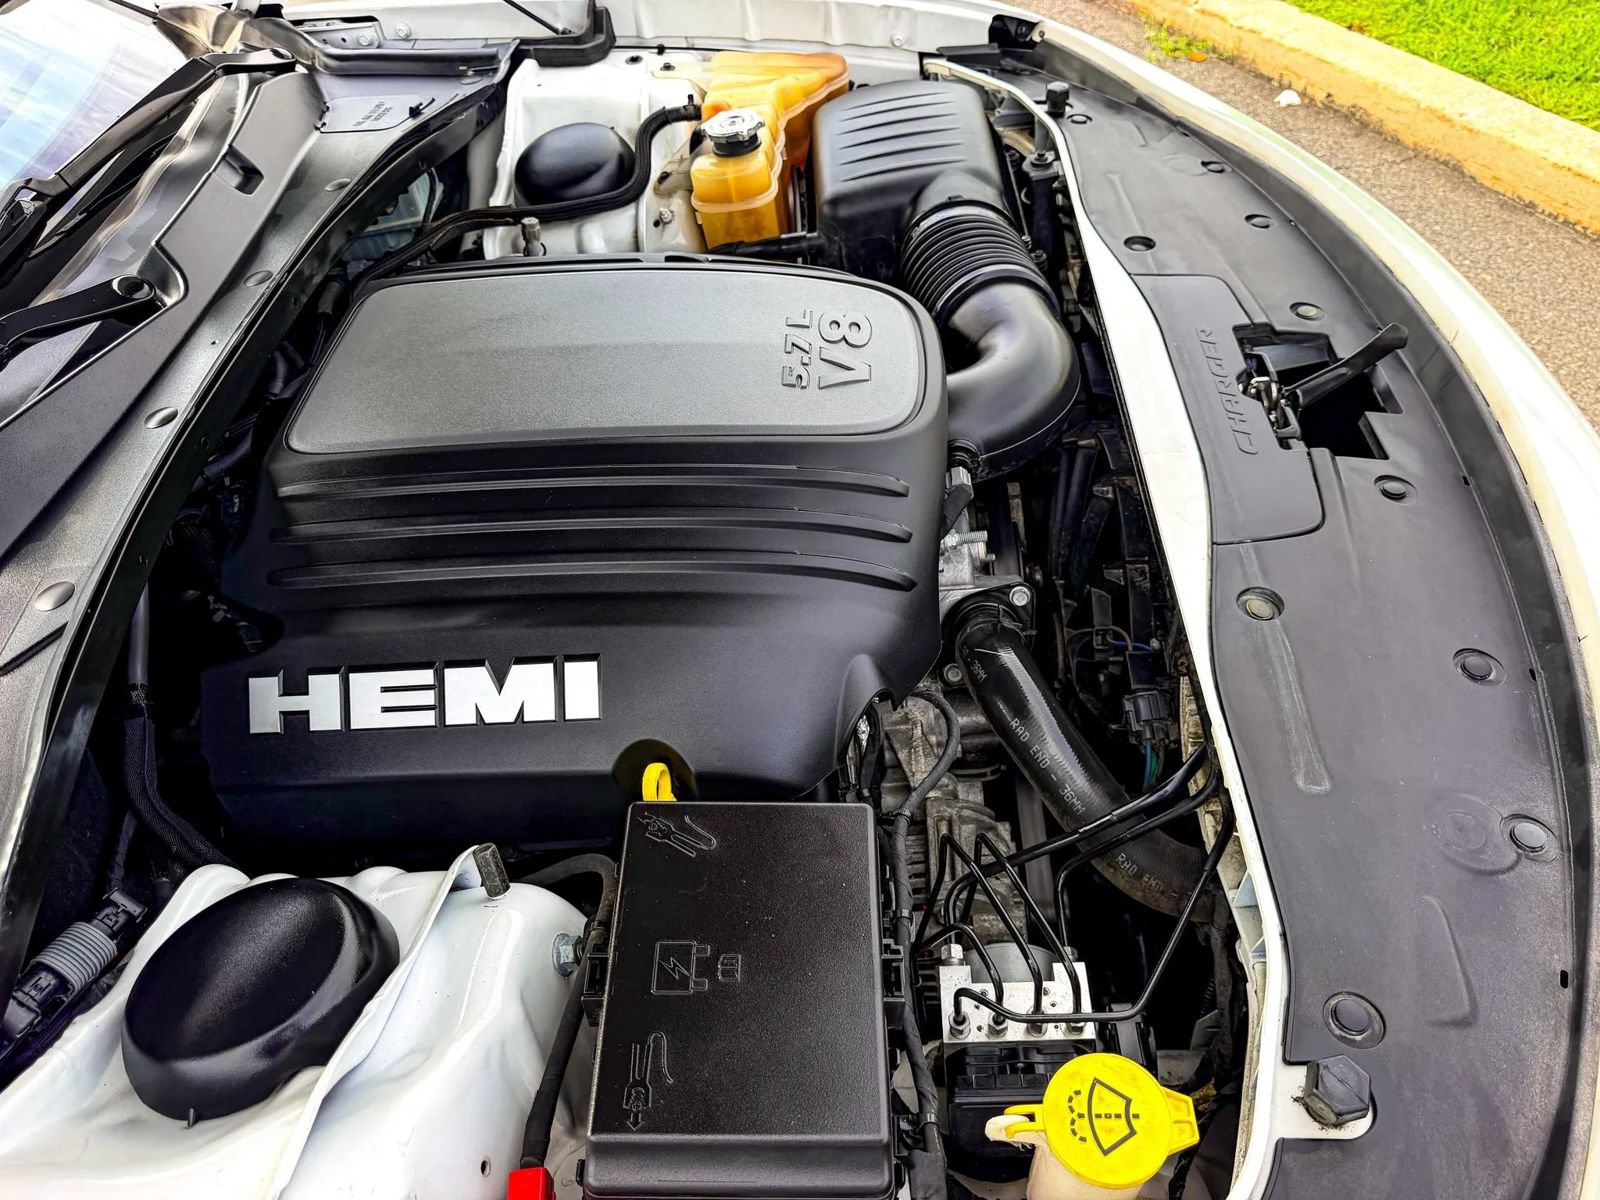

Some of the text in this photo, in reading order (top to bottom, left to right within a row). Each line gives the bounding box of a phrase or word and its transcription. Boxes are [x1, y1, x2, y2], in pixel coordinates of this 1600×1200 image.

[782, 309, 813, 389] 5.7L
[818, 311, 872, 390] V8
[1195, 328, 1258, 455] CHARGER
[248, 655, 601, 734] HEMI
[1009, 718, 1030, 743] RAD
[1029, 745, 1050, 769] END
[1058, 783, 1086, 815] 36MM
